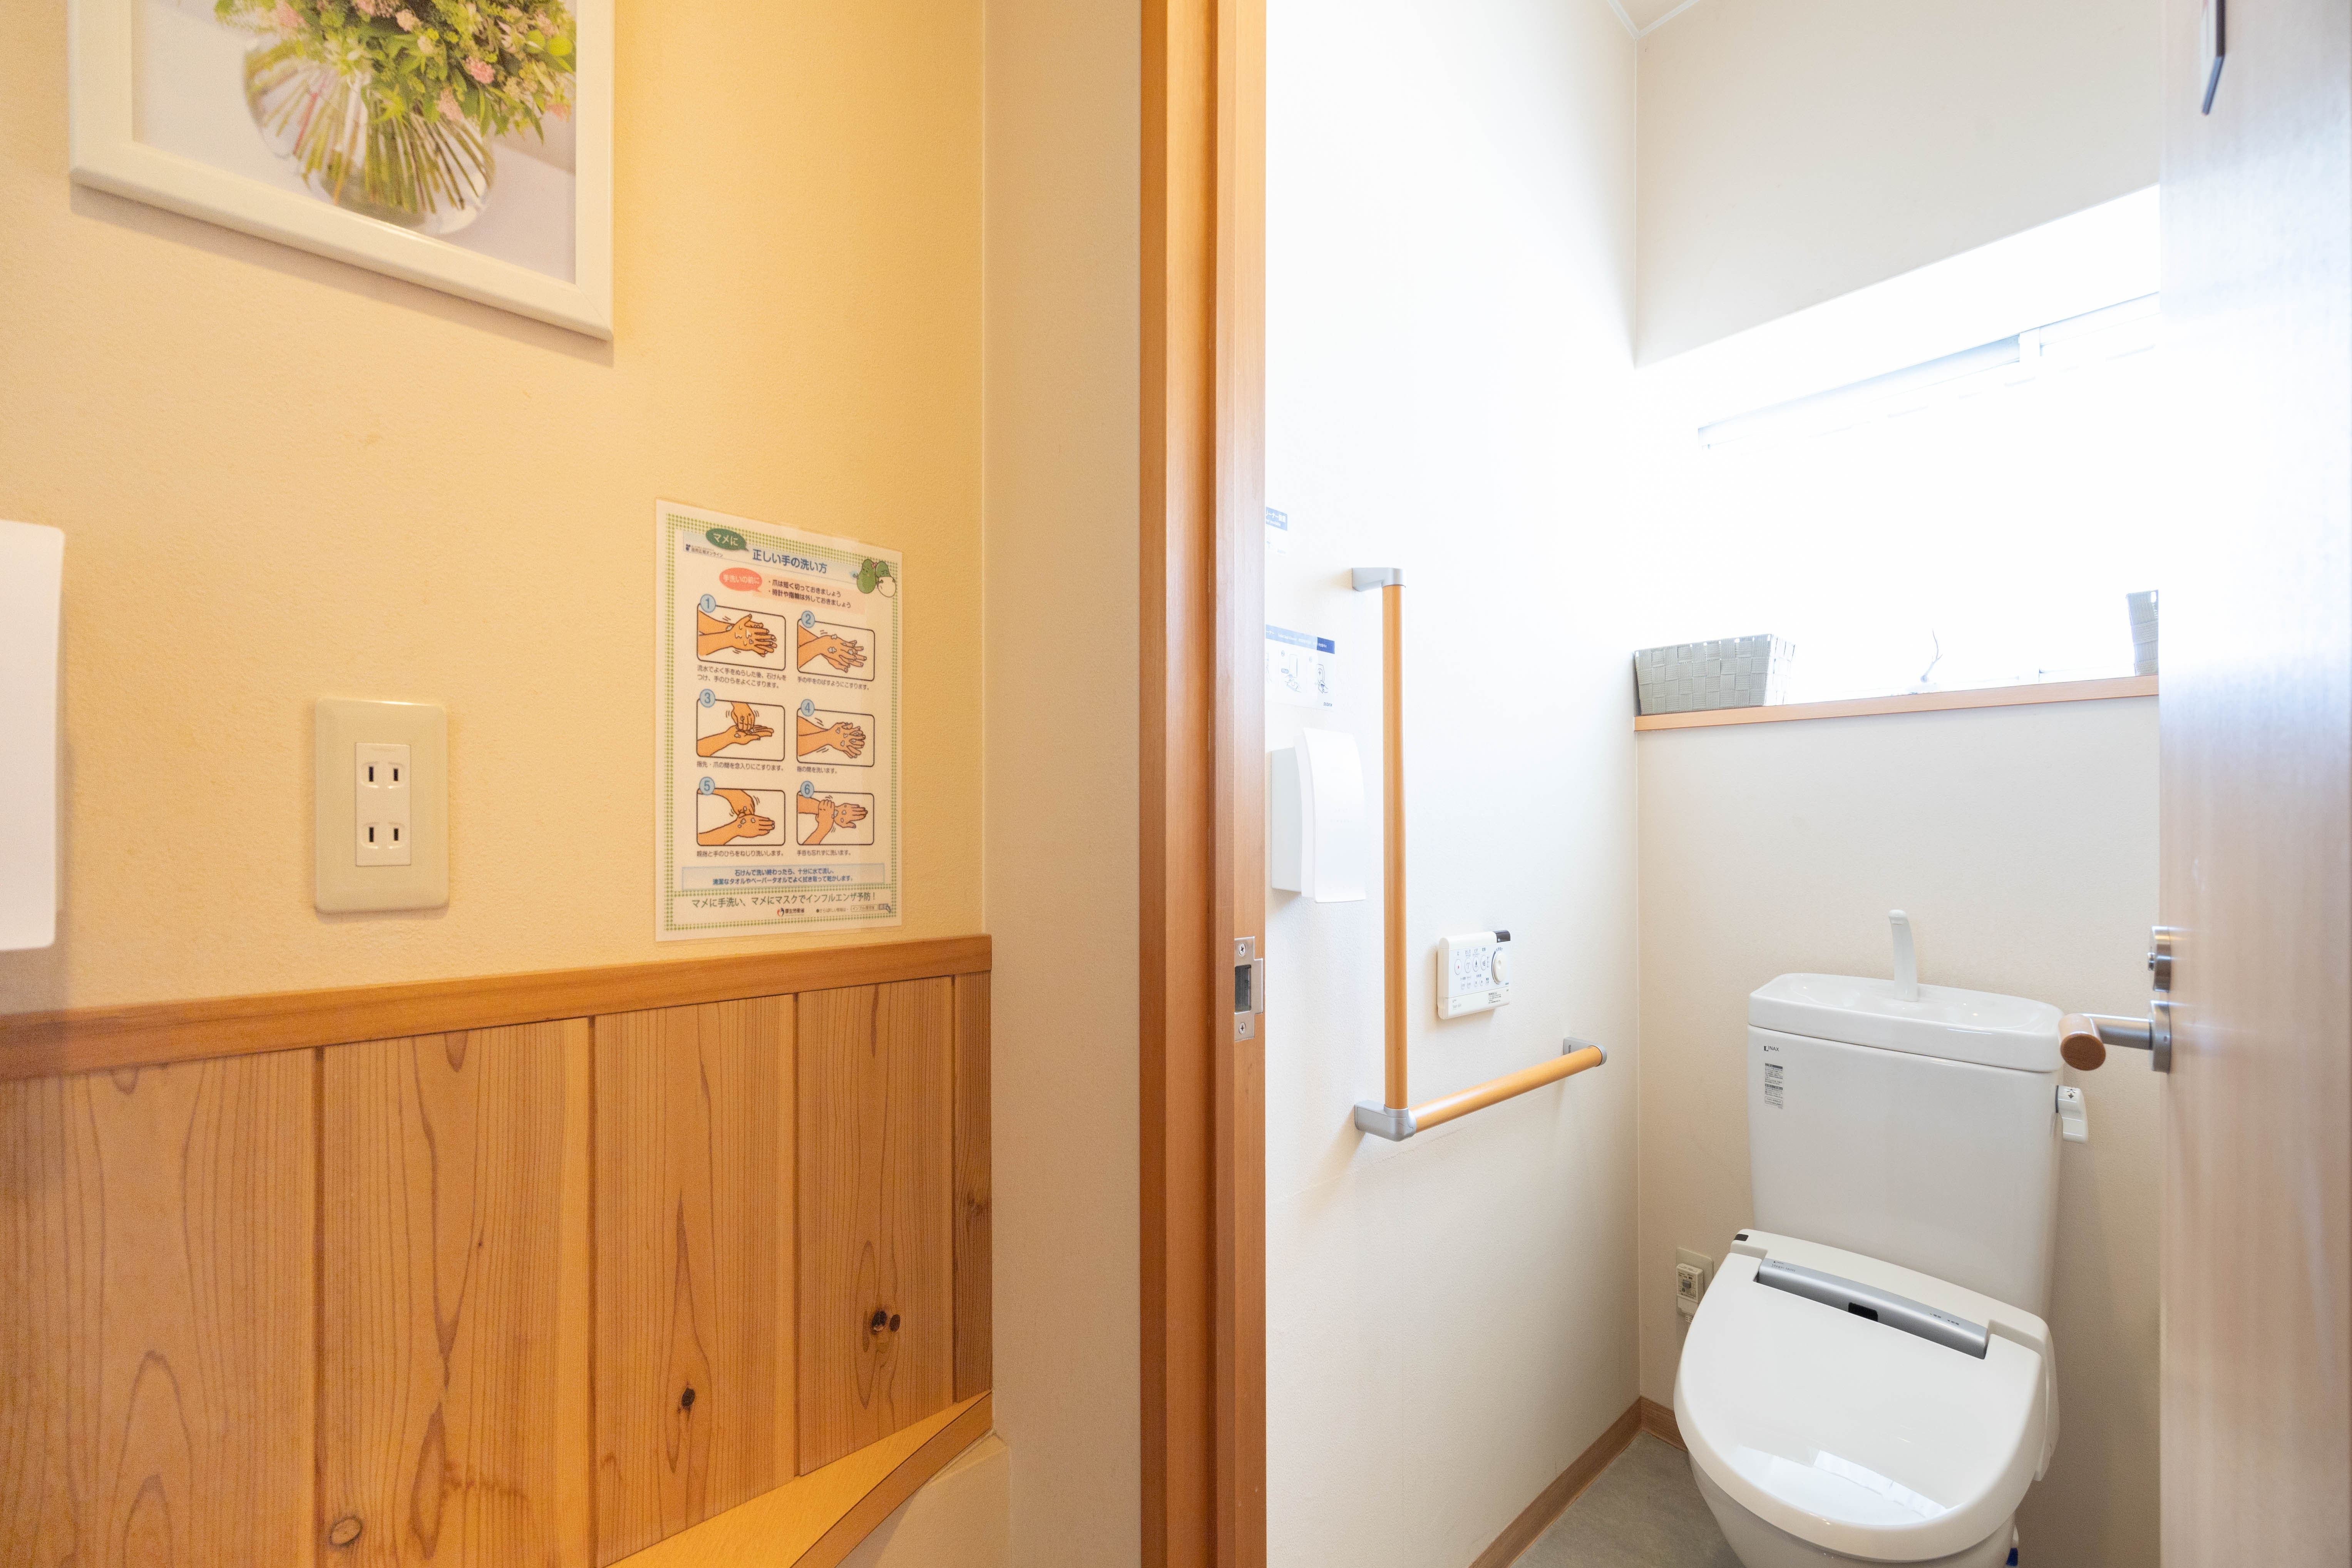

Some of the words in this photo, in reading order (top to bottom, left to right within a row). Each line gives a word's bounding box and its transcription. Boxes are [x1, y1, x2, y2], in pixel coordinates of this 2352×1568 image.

[713, 533, 738, 546] マメに
[752, 549, 827, 574] 正しい手の洗い方
[723, 574, 760, 584] 手洗いの前に
[705, 597, 710, 609] 1
[805, 614, 811, 624] 2
[697, 674, 779, 688] つけ、手のひらをよくこすります。
[797, 676, 869, 690] 手の甲をのばすようにこすります。
[704, 692, 710, 704] 3
[805, 703, 811, 713] 4
[704, 780, 710, 791] 5
[804, 784, 810, 795] 6
